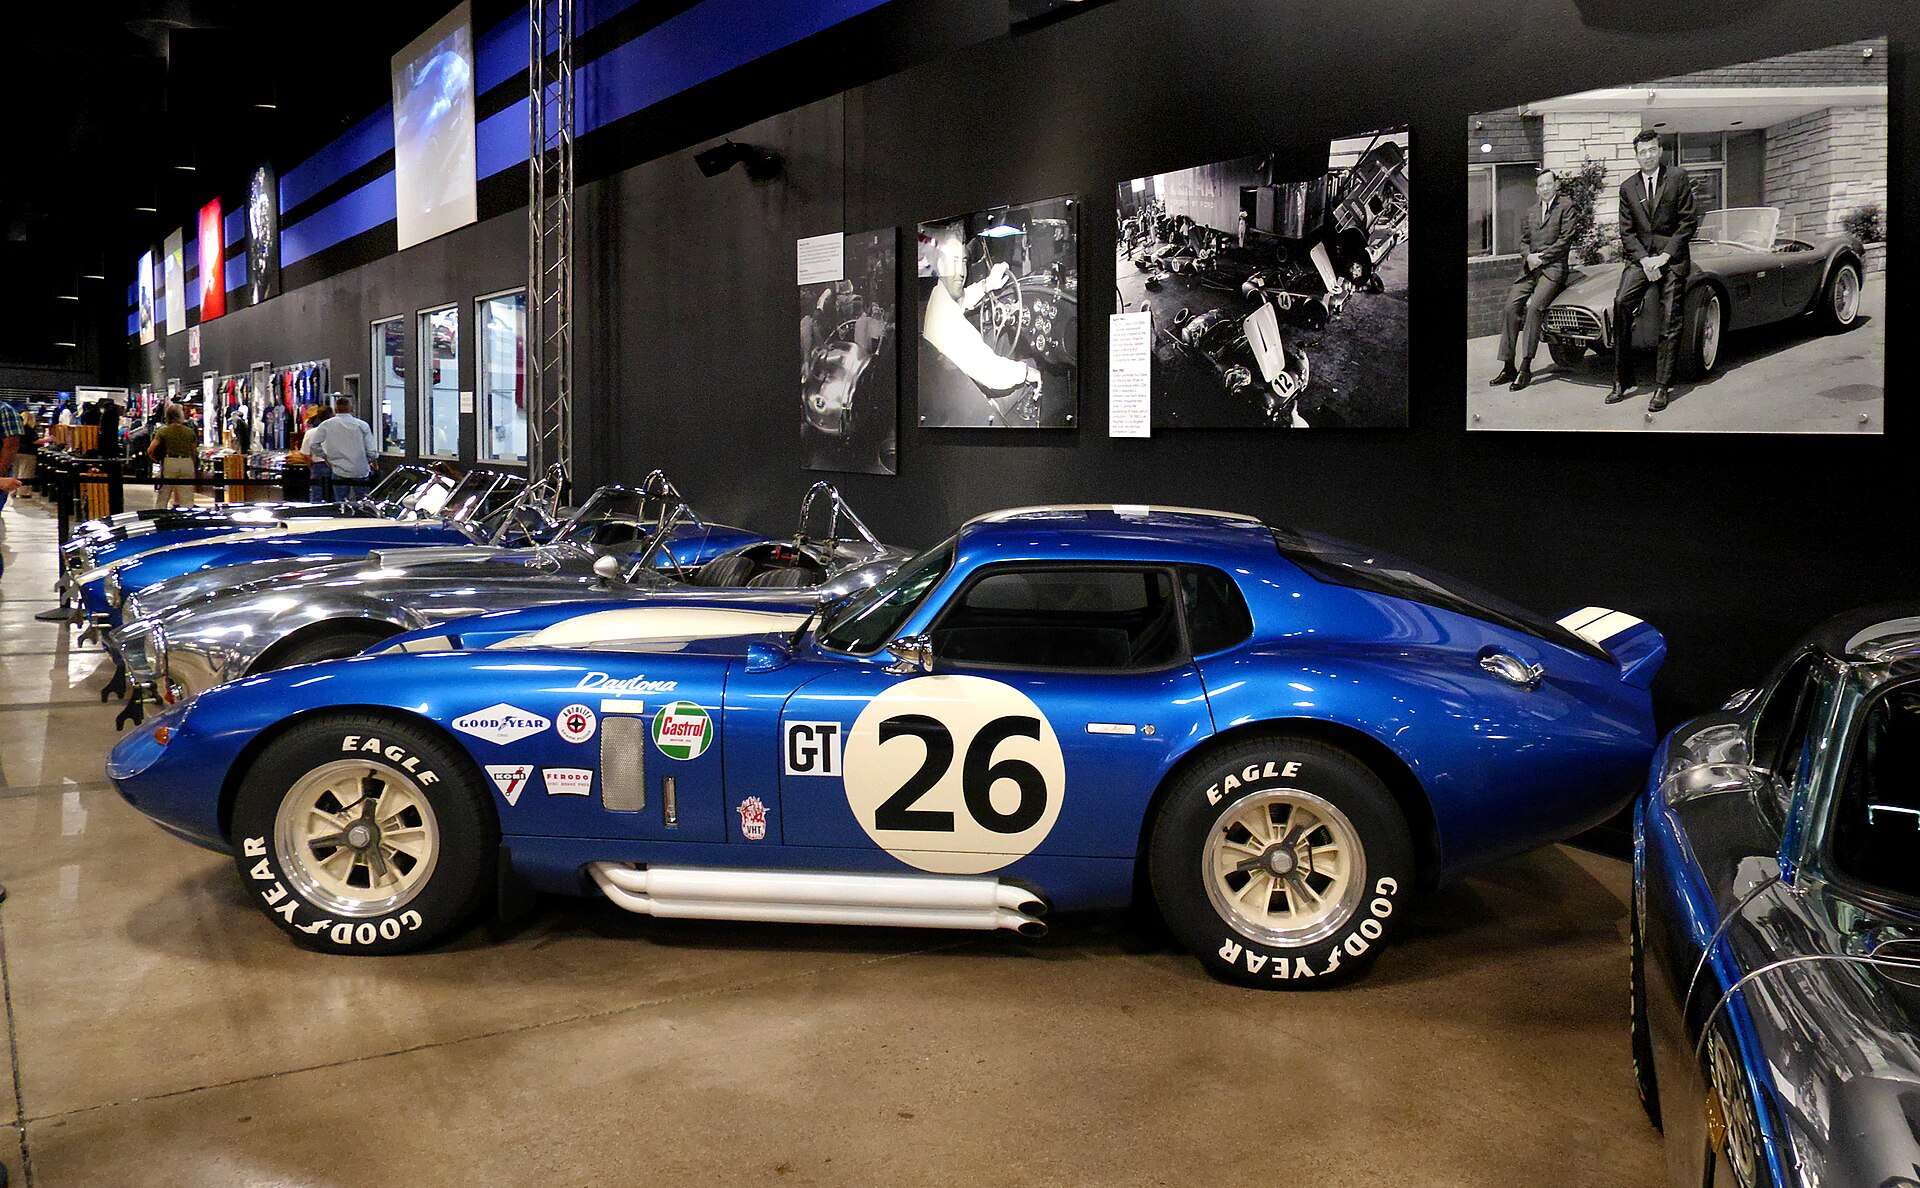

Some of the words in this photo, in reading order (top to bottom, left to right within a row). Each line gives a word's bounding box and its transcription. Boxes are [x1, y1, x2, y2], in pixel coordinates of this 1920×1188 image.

[1274, 373, 1293, 394] 12
[575, 671, 678, 697] Daytona
[661, 716, 706, 737] Castrol
[789, 724, 837, 772] GT
[341, 735, 440, 786] EAGLE
[494, 772, 526, 781] KONI
[546, 773, 589, 781] FERODO
[874, 713, 1048, 834] 26
[1206, 761, 1302, 806] EAGLE
[746, 825, 761, 835] VHT
